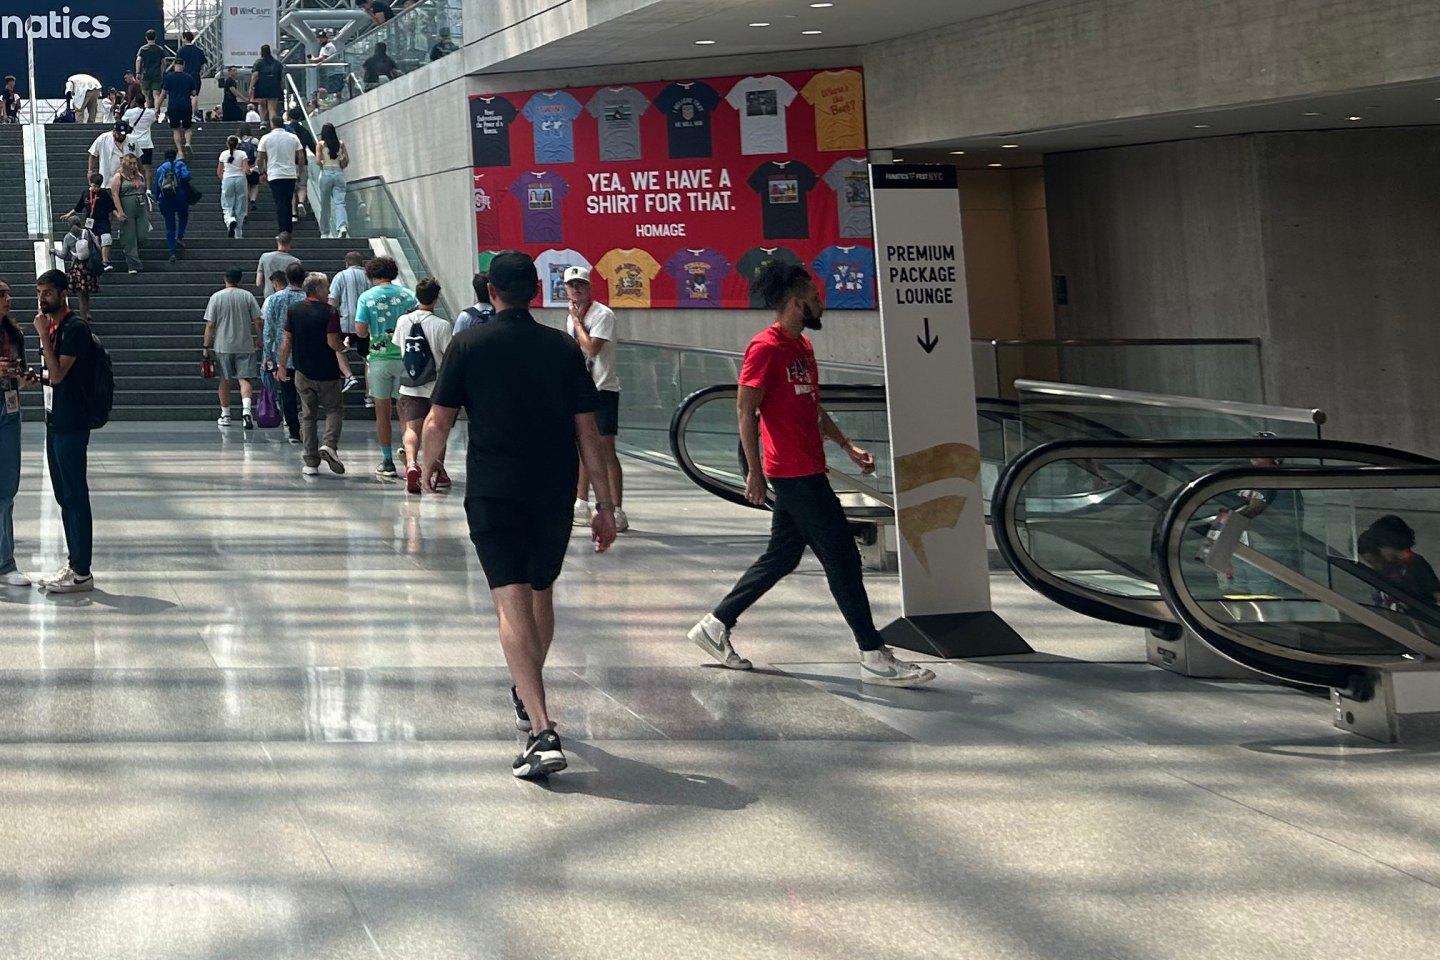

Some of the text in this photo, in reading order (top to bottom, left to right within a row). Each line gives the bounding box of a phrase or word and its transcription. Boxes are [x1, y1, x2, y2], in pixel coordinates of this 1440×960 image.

[586, 166, 732, 195] YEA, WE HAVE A
[586, 188, 737, 215] SHIRT FOR THAT.
[635, 222, 686, 238] HOMAGE
[887, 245, 955, 262] PREMIUM
[890, 266, 956, 283] PACKAGE
[896, 287, 953, 305] LOUNGE
